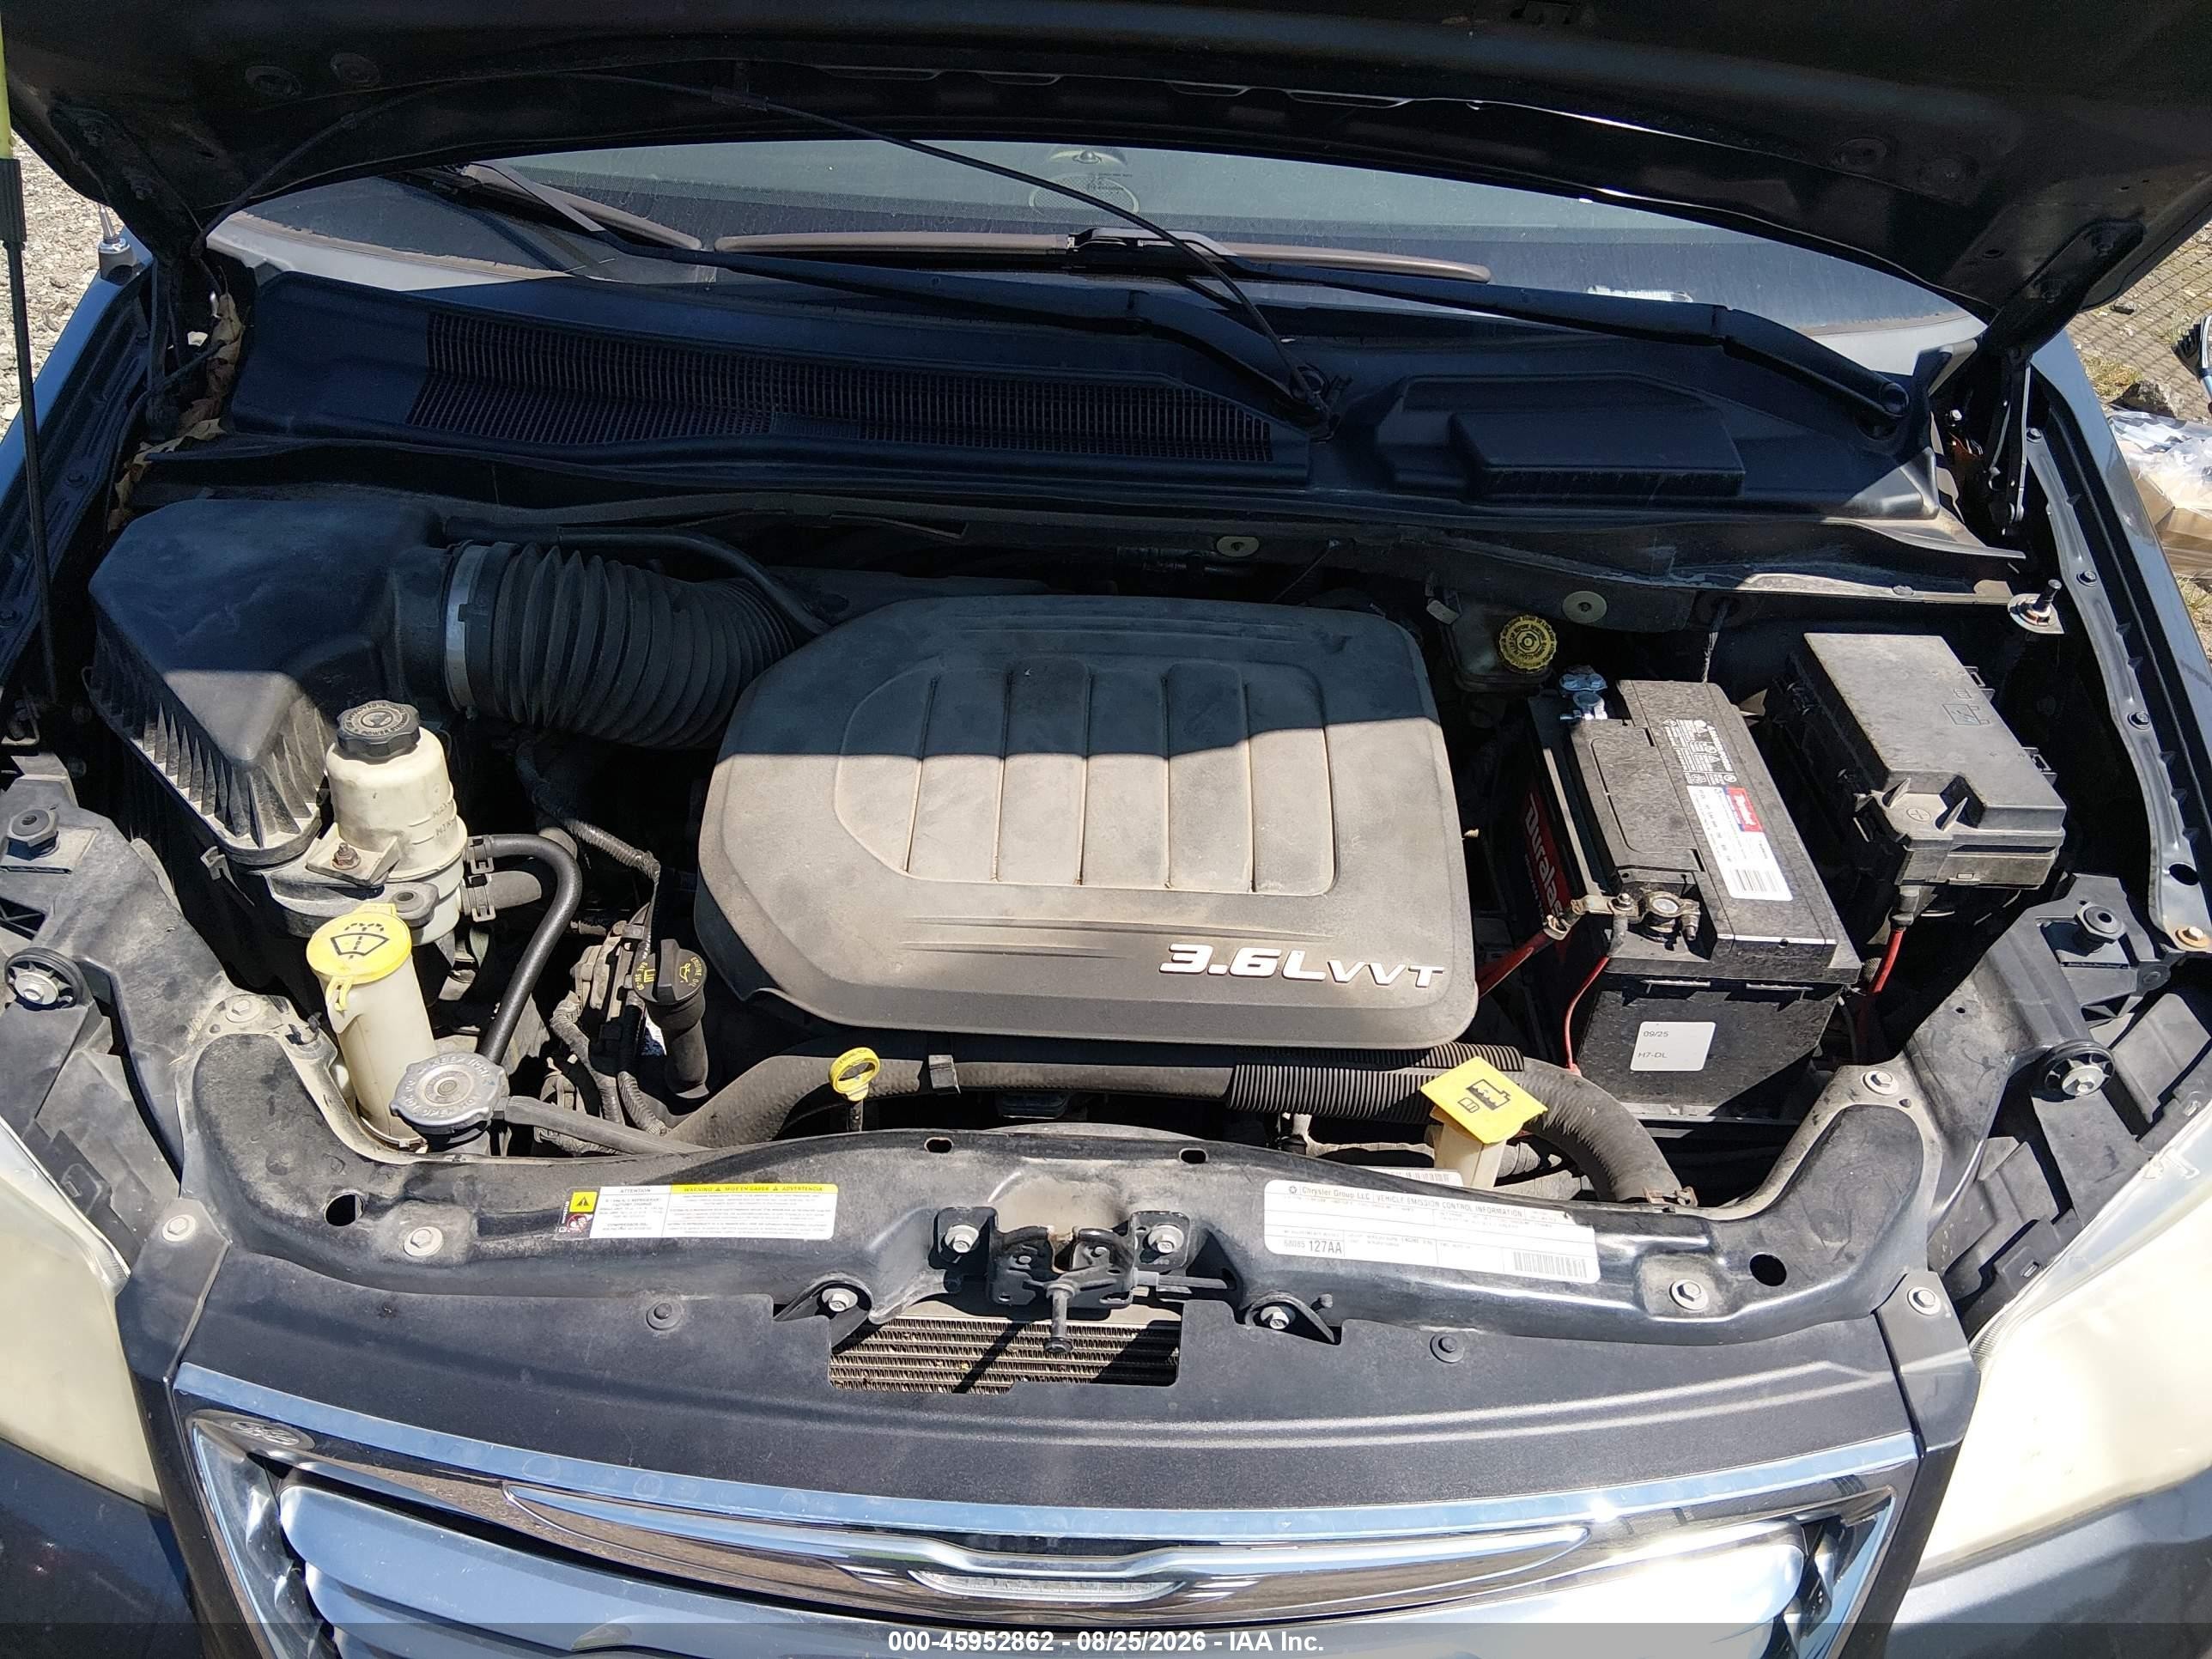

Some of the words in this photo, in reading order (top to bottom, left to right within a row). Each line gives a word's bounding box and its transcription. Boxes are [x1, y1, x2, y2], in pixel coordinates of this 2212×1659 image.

[1525, 792, 1564, 916] Duralas
[1159, 942, 1327, 982] 3.6L
[1326, 958, 1445, 988] VVT
[688, 978, 700, 988] OIL
[1302, 1187, 1331, 1197] Chrysler
[1333, 1190, 1355, 1200] Group
[1357, 1191, 1370, 1200] LLC
[1376, 1194, 1405, 1204] VEHICLE
[1407, 1197, 1440, 1207] EMISSION
[1442, 1201, 1474, 1212] CONTROL
[1474, 1205, 1523, 1218] INFORMATION
[1310, 1240, 1342, 1255] 127AA
